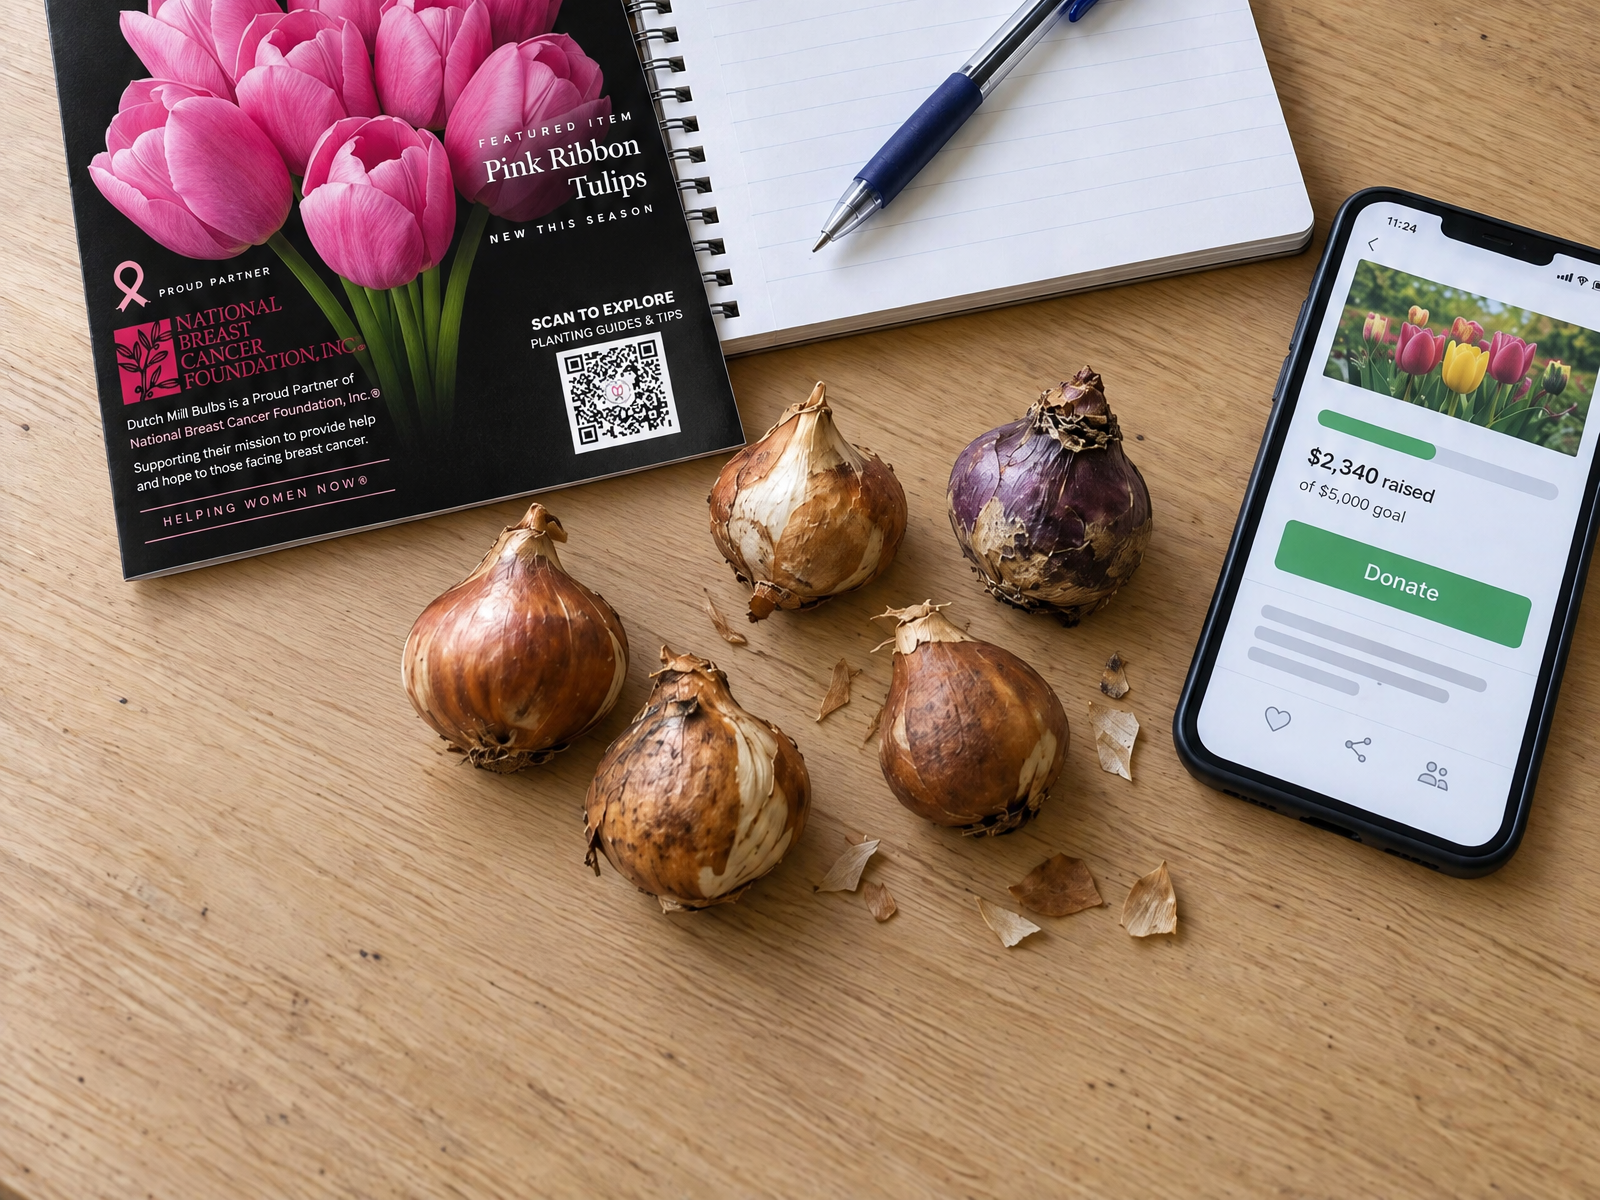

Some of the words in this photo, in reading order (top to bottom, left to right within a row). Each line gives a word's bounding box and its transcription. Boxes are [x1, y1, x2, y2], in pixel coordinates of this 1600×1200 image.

[479, 122, 576, 148] FEATURED
[588, 111, 632, 128] ITEM
[483, 150, 545, 184] Pink
[547, 137, 641, 171] Ribbon
[567, 169, 647, 200] Tulips
[489, 228, 526, 244] NEW
[536, 219, 576, 235] THIS
[586, 204, 654, 225] SEASON
[1387, 216, 1417, 234] 11:24
[159, 280, 203, 298] PROUD
[210, 266, 271, 287] PARTNER
[175, 296, 283, 332] NATIONAL
[530, 327, 593, 349] PLANTING
[596, 317, 642, 335] GUIDES
[645, 314, 655, 326] &
[655, 309, 684, 324] TIPS
[531, 311, 576, 331] SCAN
[577, 306, 600, 321] TO
[602, 290, 676, 317] EXPLORE
[178, 320, 252, 351] BREAST
[180, 338, 266, 370] CANCER
[183, 345, 320, 390] FOUNDATION,
[127, 414, 164, 431] Dutch
[191, 401, 226, 417] Bulbs
[228, 398, 239, 409] is
[242, 397, 250, 407] a
[252, 386, 289, 404] Proud
[292, 378, 339, 396] Partner
[341, 372, 354, 385] of
[130, 428, 182, 449] National
[184, 420, 225, 437] Breast
[227, 411, 270, 428] Cancer
[273, 397, 346, 419] Foundation,
[133, 452, 201, 474] Supporting
[203, 444, 231, 459] their
[235, 435, 281, 452] mission
[283, 432, 296, 442] to
[300, 421, 346, 441] provide
[349, 414, 376, 429] help
[137, 477, 159, 492] and
[162, 472, 192, 486] hope
[194, 469, 208, 479] to
[209, 461, 243, 476] those
[245, 453, 283, 468] facing
[284, 443, 323, 460] breast
[325, 435, 369, 452] cancer.
[1307, 446, 1379, 484] $2,340
[1381, 477, 1436, 504] raised
[163, 503, 236, 527] HELPING
[244, 487, 307, 509] WOMEN
[1299, 480, 1316, 493] of
[1318, 484, 1370, 511] $5,000
[1372, 504, 1407, 523] goal
[1363, 562, 1439, 602] Donate
